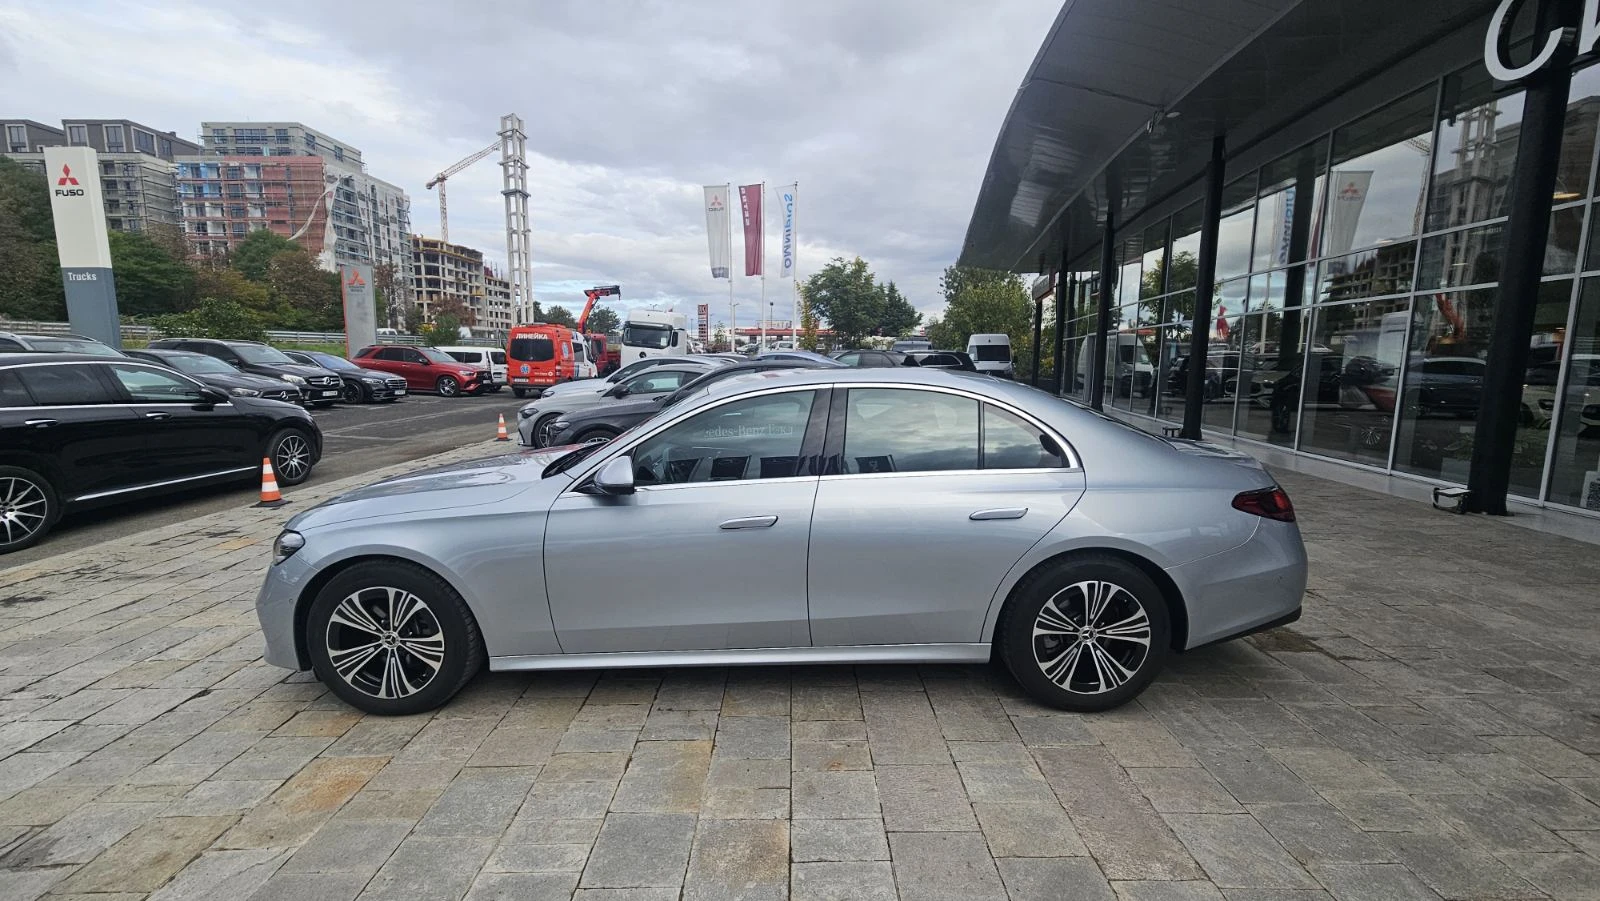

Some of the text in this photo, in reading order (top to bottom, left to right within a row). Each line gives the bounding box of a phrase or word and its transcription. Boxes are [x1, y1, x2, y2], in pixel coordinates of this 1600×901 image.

[55, 189, 84, 197] FUSO
[67, 272, 97, 281] Trucks
[515, 332, 548, 340] ЛИНЕЙКА
